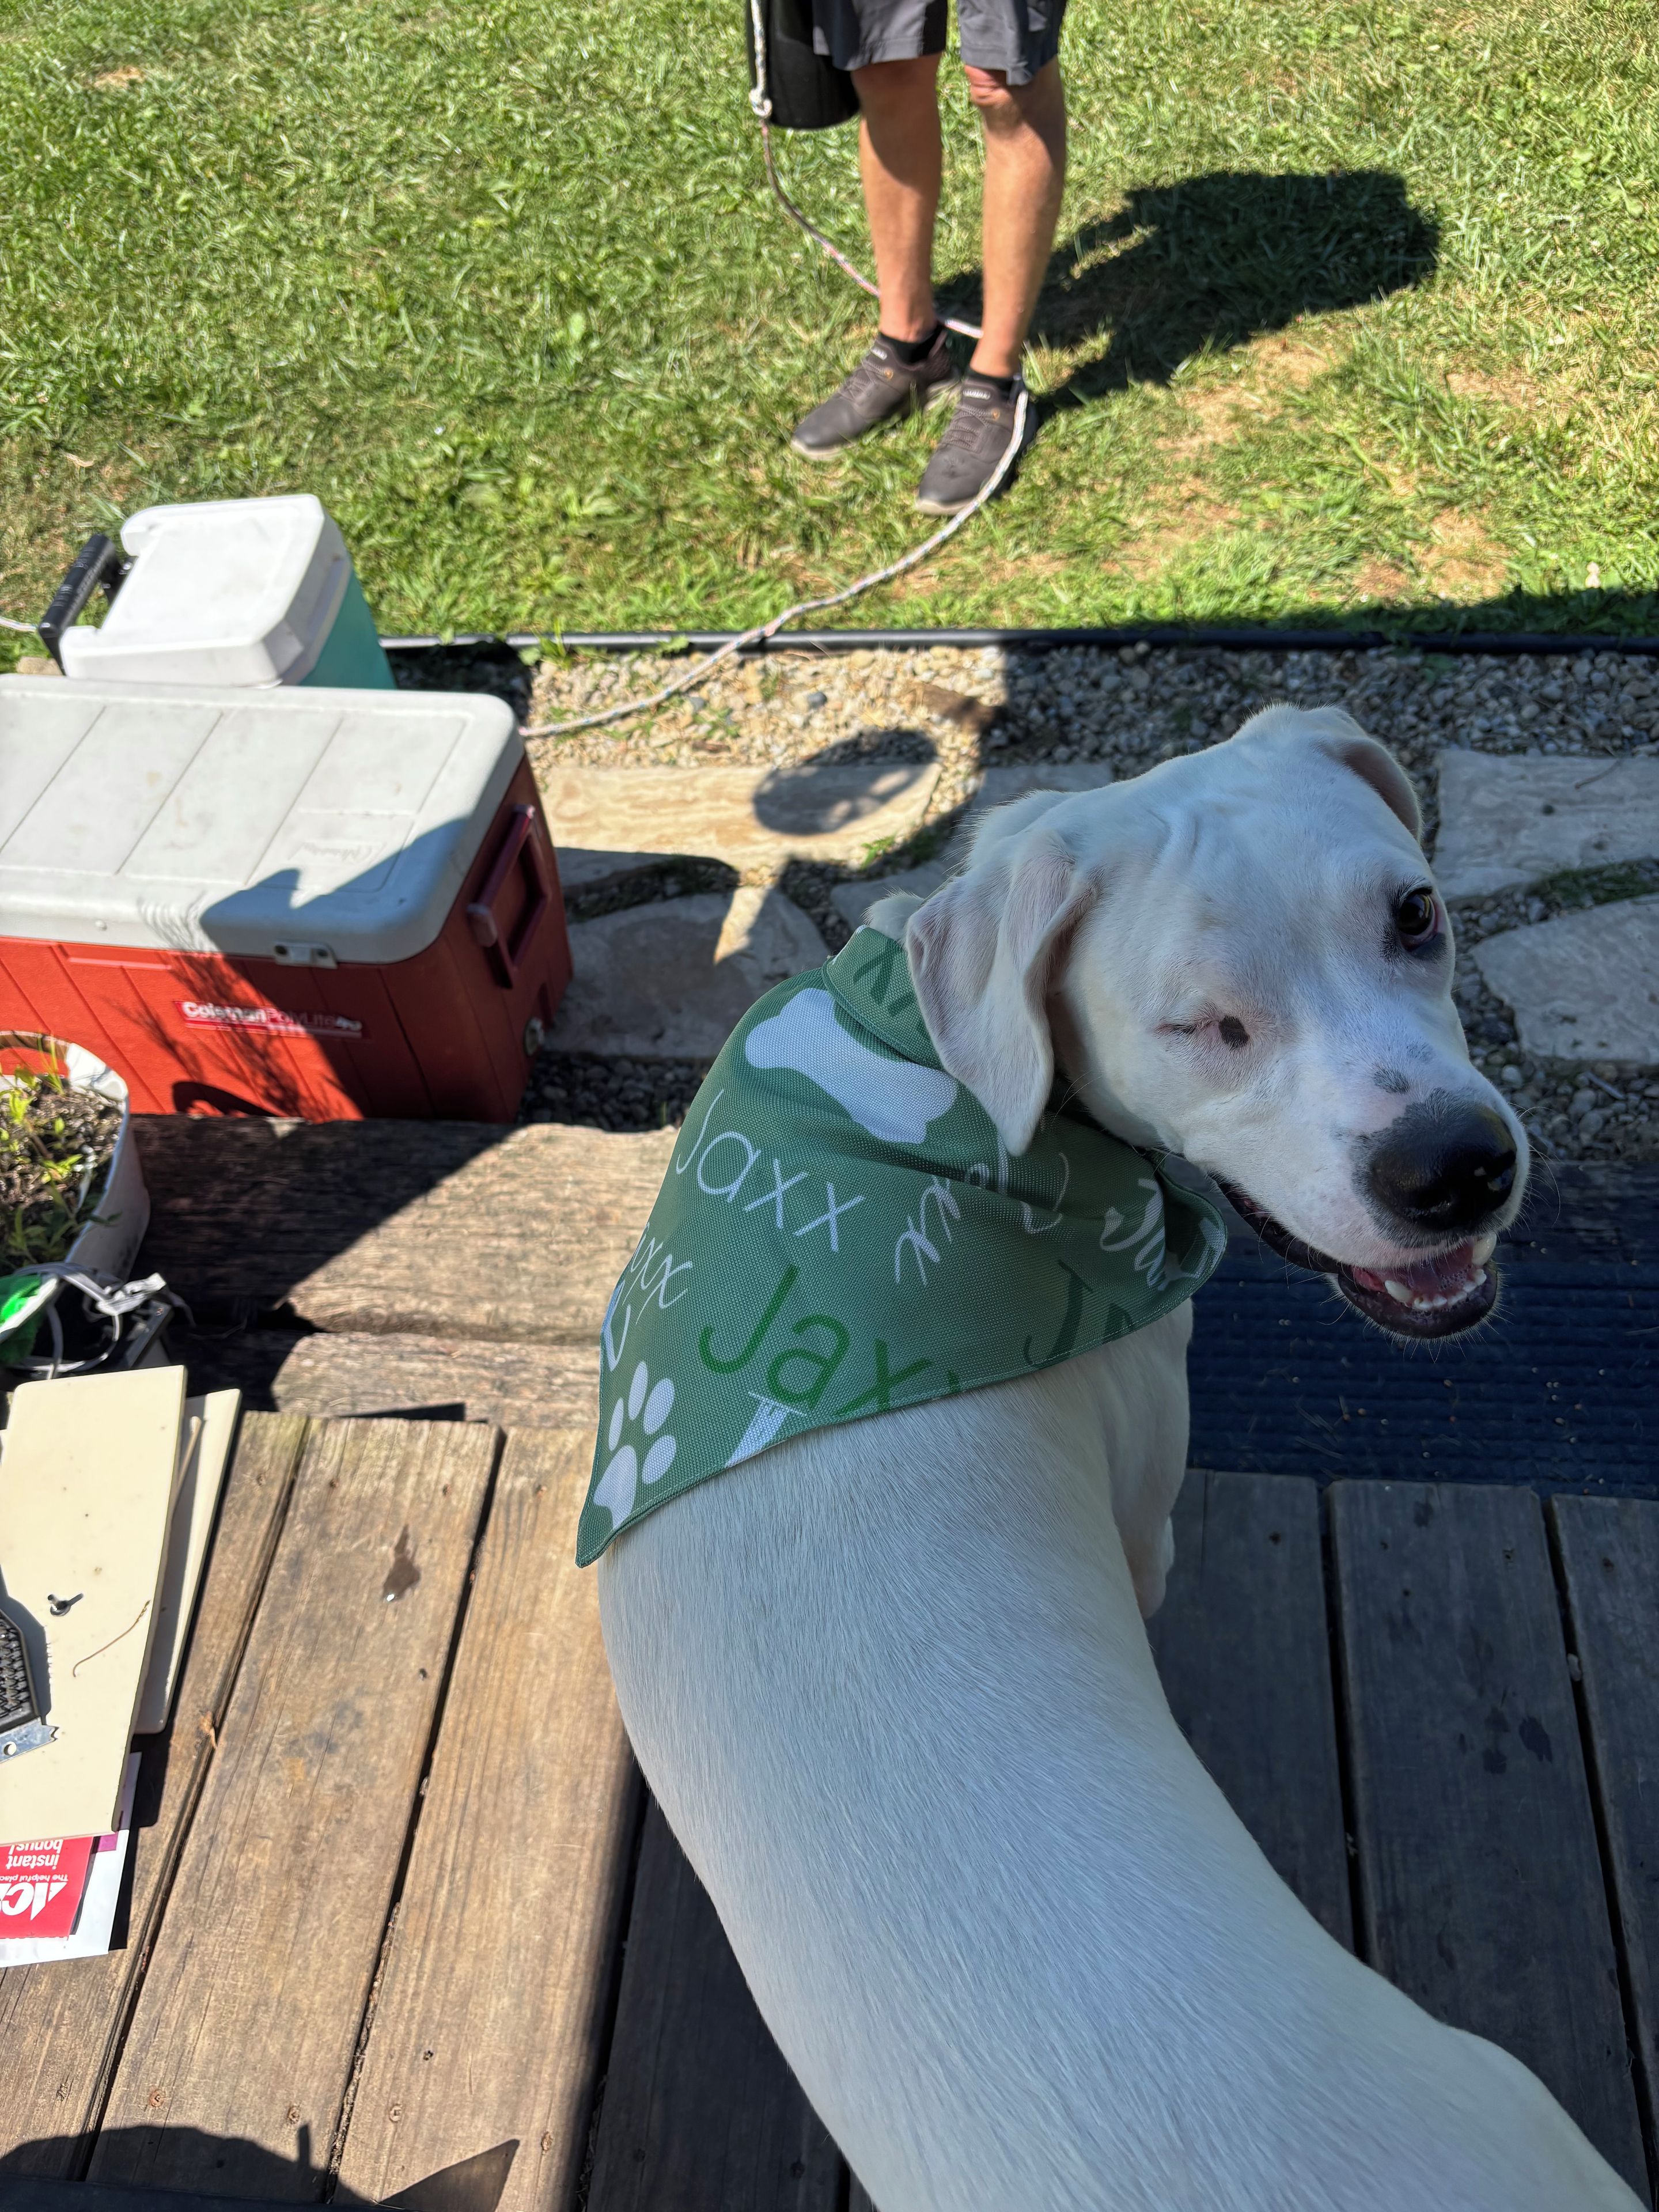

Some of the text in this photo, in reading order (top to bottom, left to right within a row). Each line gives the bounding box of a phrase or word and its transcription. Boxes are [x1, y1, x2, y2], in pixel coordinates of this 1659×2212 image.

[676, 1089, 864, 1252] Jaxx
[698, 1265, 960, 1412] Jax
[5, 1854, 60, 1870] instant
[20, 1873, 51, 1882] helpful
[52, 1874, 69, 1882] The
[0, 1882, 67, 1921] AC
